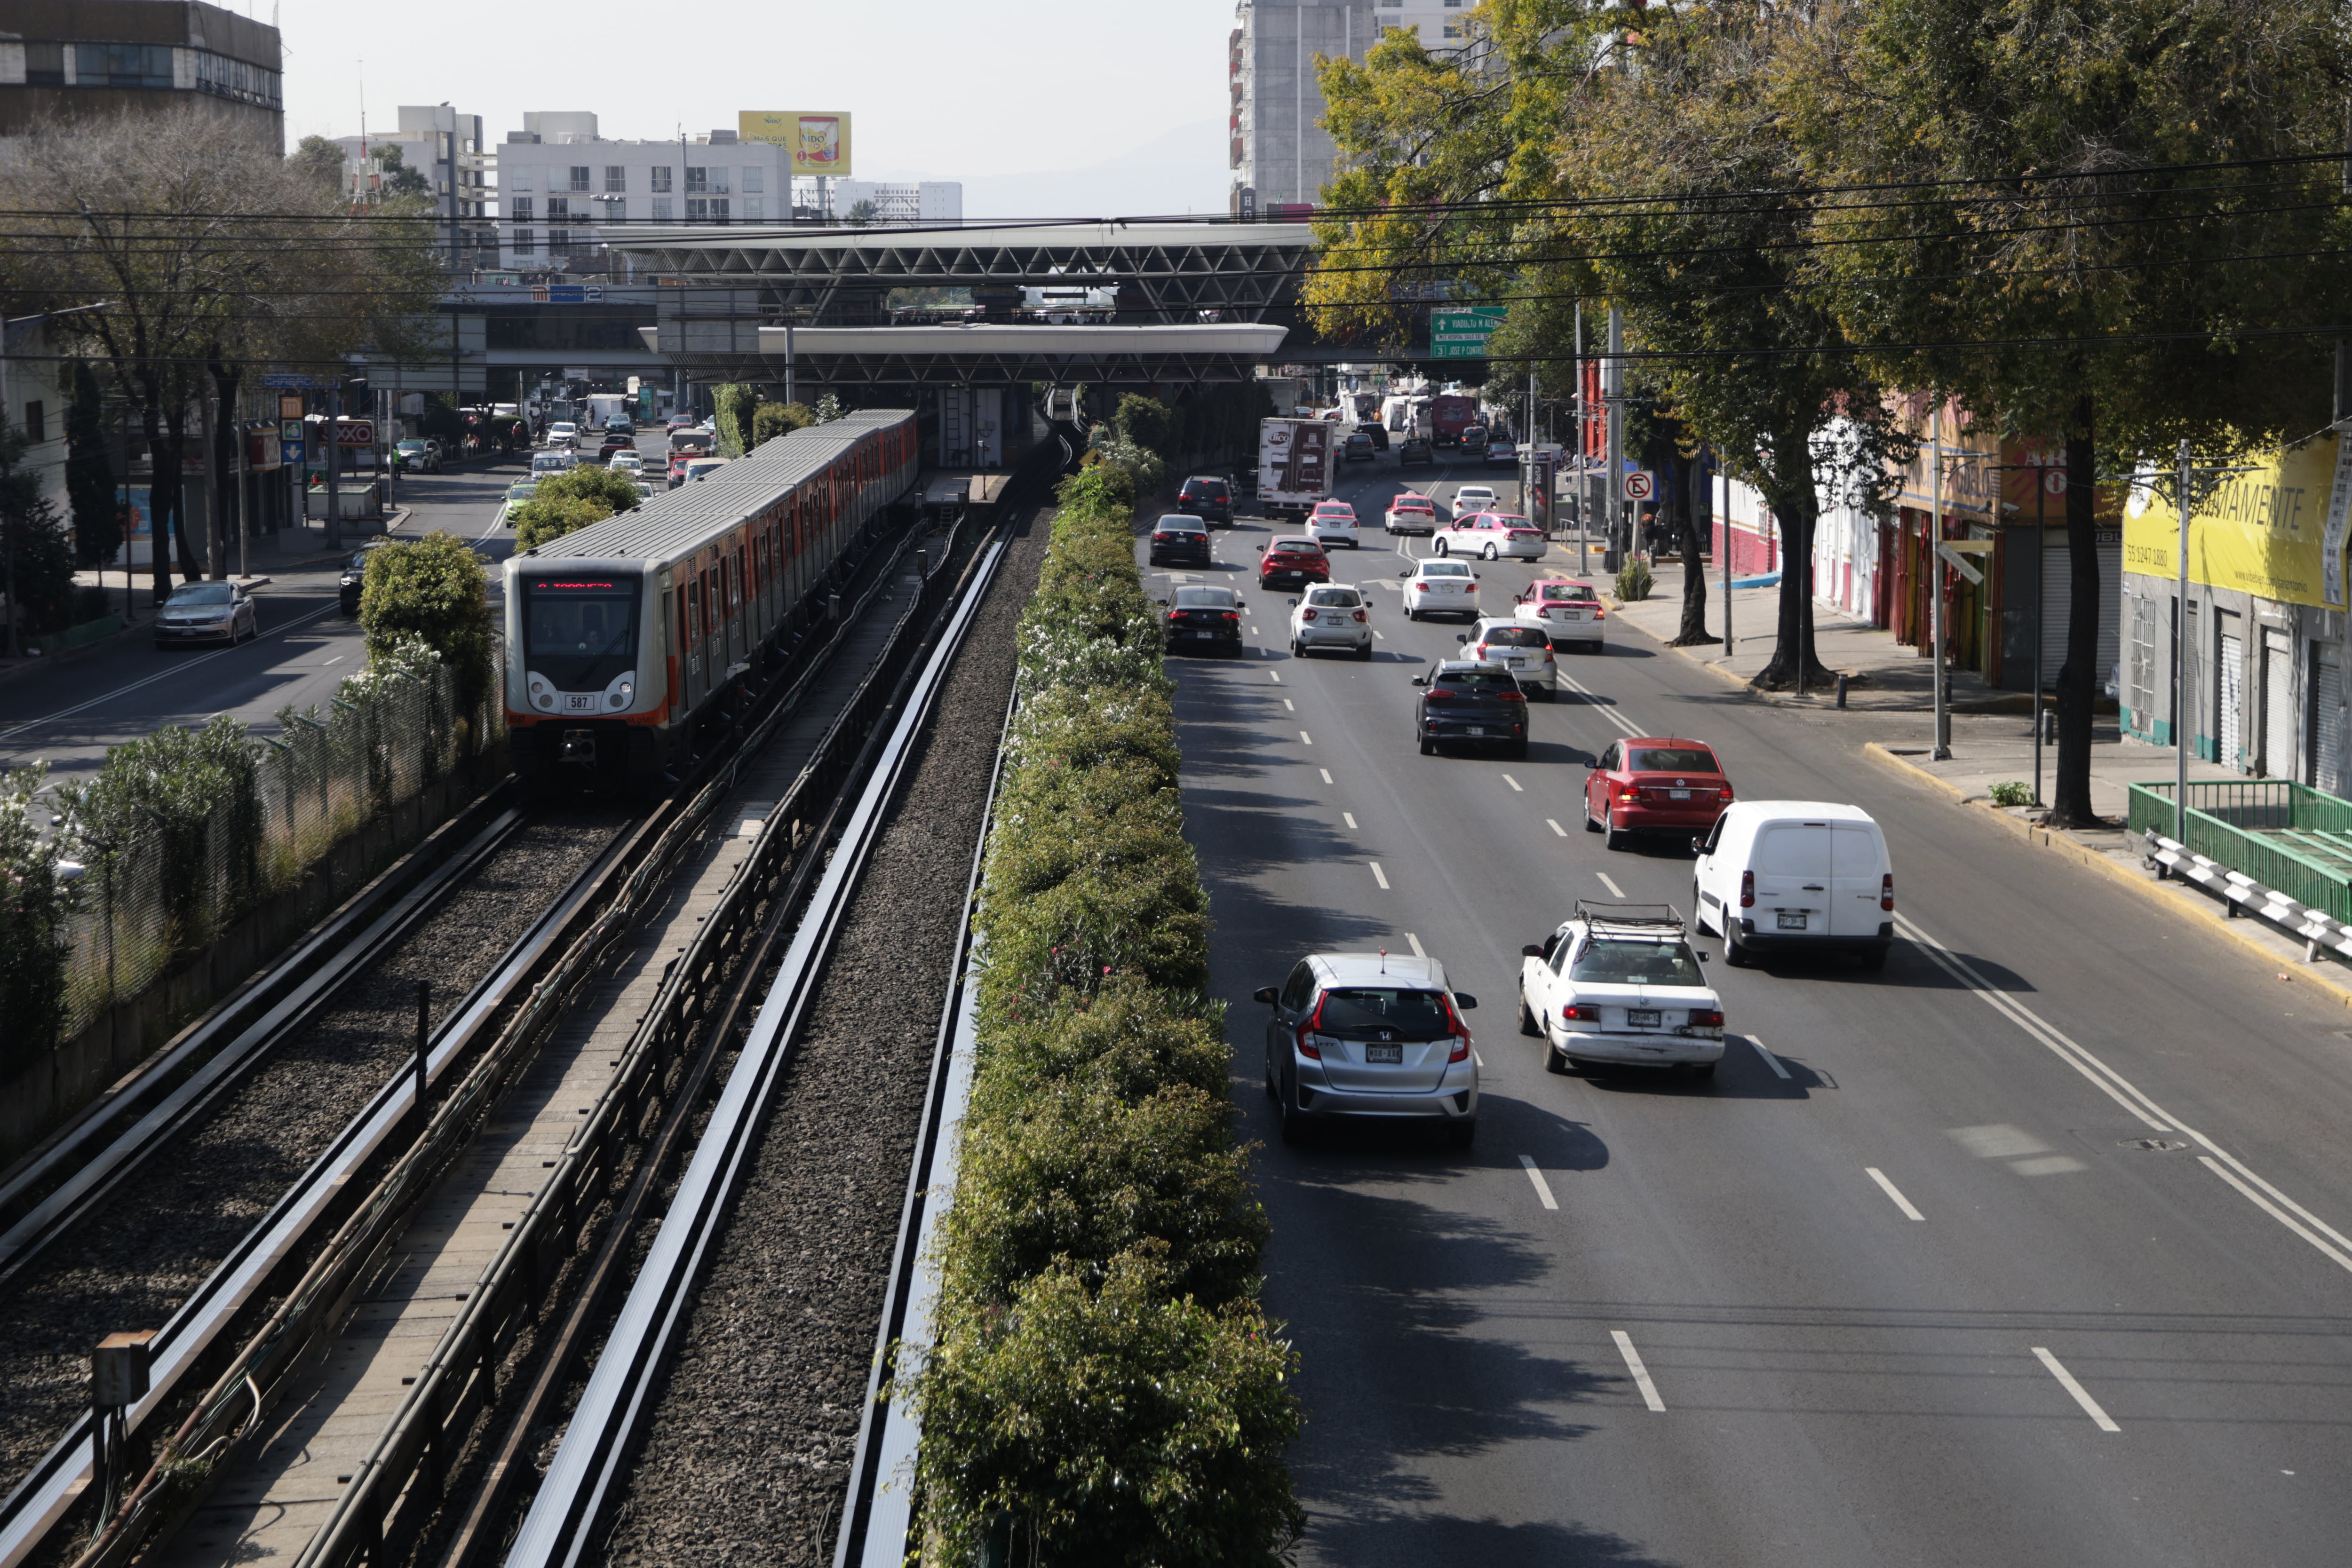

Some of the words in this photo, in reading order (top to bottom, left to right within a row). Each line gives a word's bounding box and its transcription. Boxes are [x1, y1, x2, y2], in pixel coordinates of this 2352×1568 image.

[802, 134, 825, 143] NIDO
[587, 286, 602, 301] 2
[1452, 319, 1477, 328] VIADUCTO
[1478, 319, 1483, 328] M
[1449, 346, 1460, 355] JOSE
[1462, 346, 1465, 355] P
[1466, 346, 1484, 355] CONTRE
[1269, 432, 1289, 442] dico
[2128, 545, 2136, 562] 55
[2137, 546, 2151, 564] 1247
[2154, 548, 2167, 567] 1880
[571, 697, 588, 708] 587
